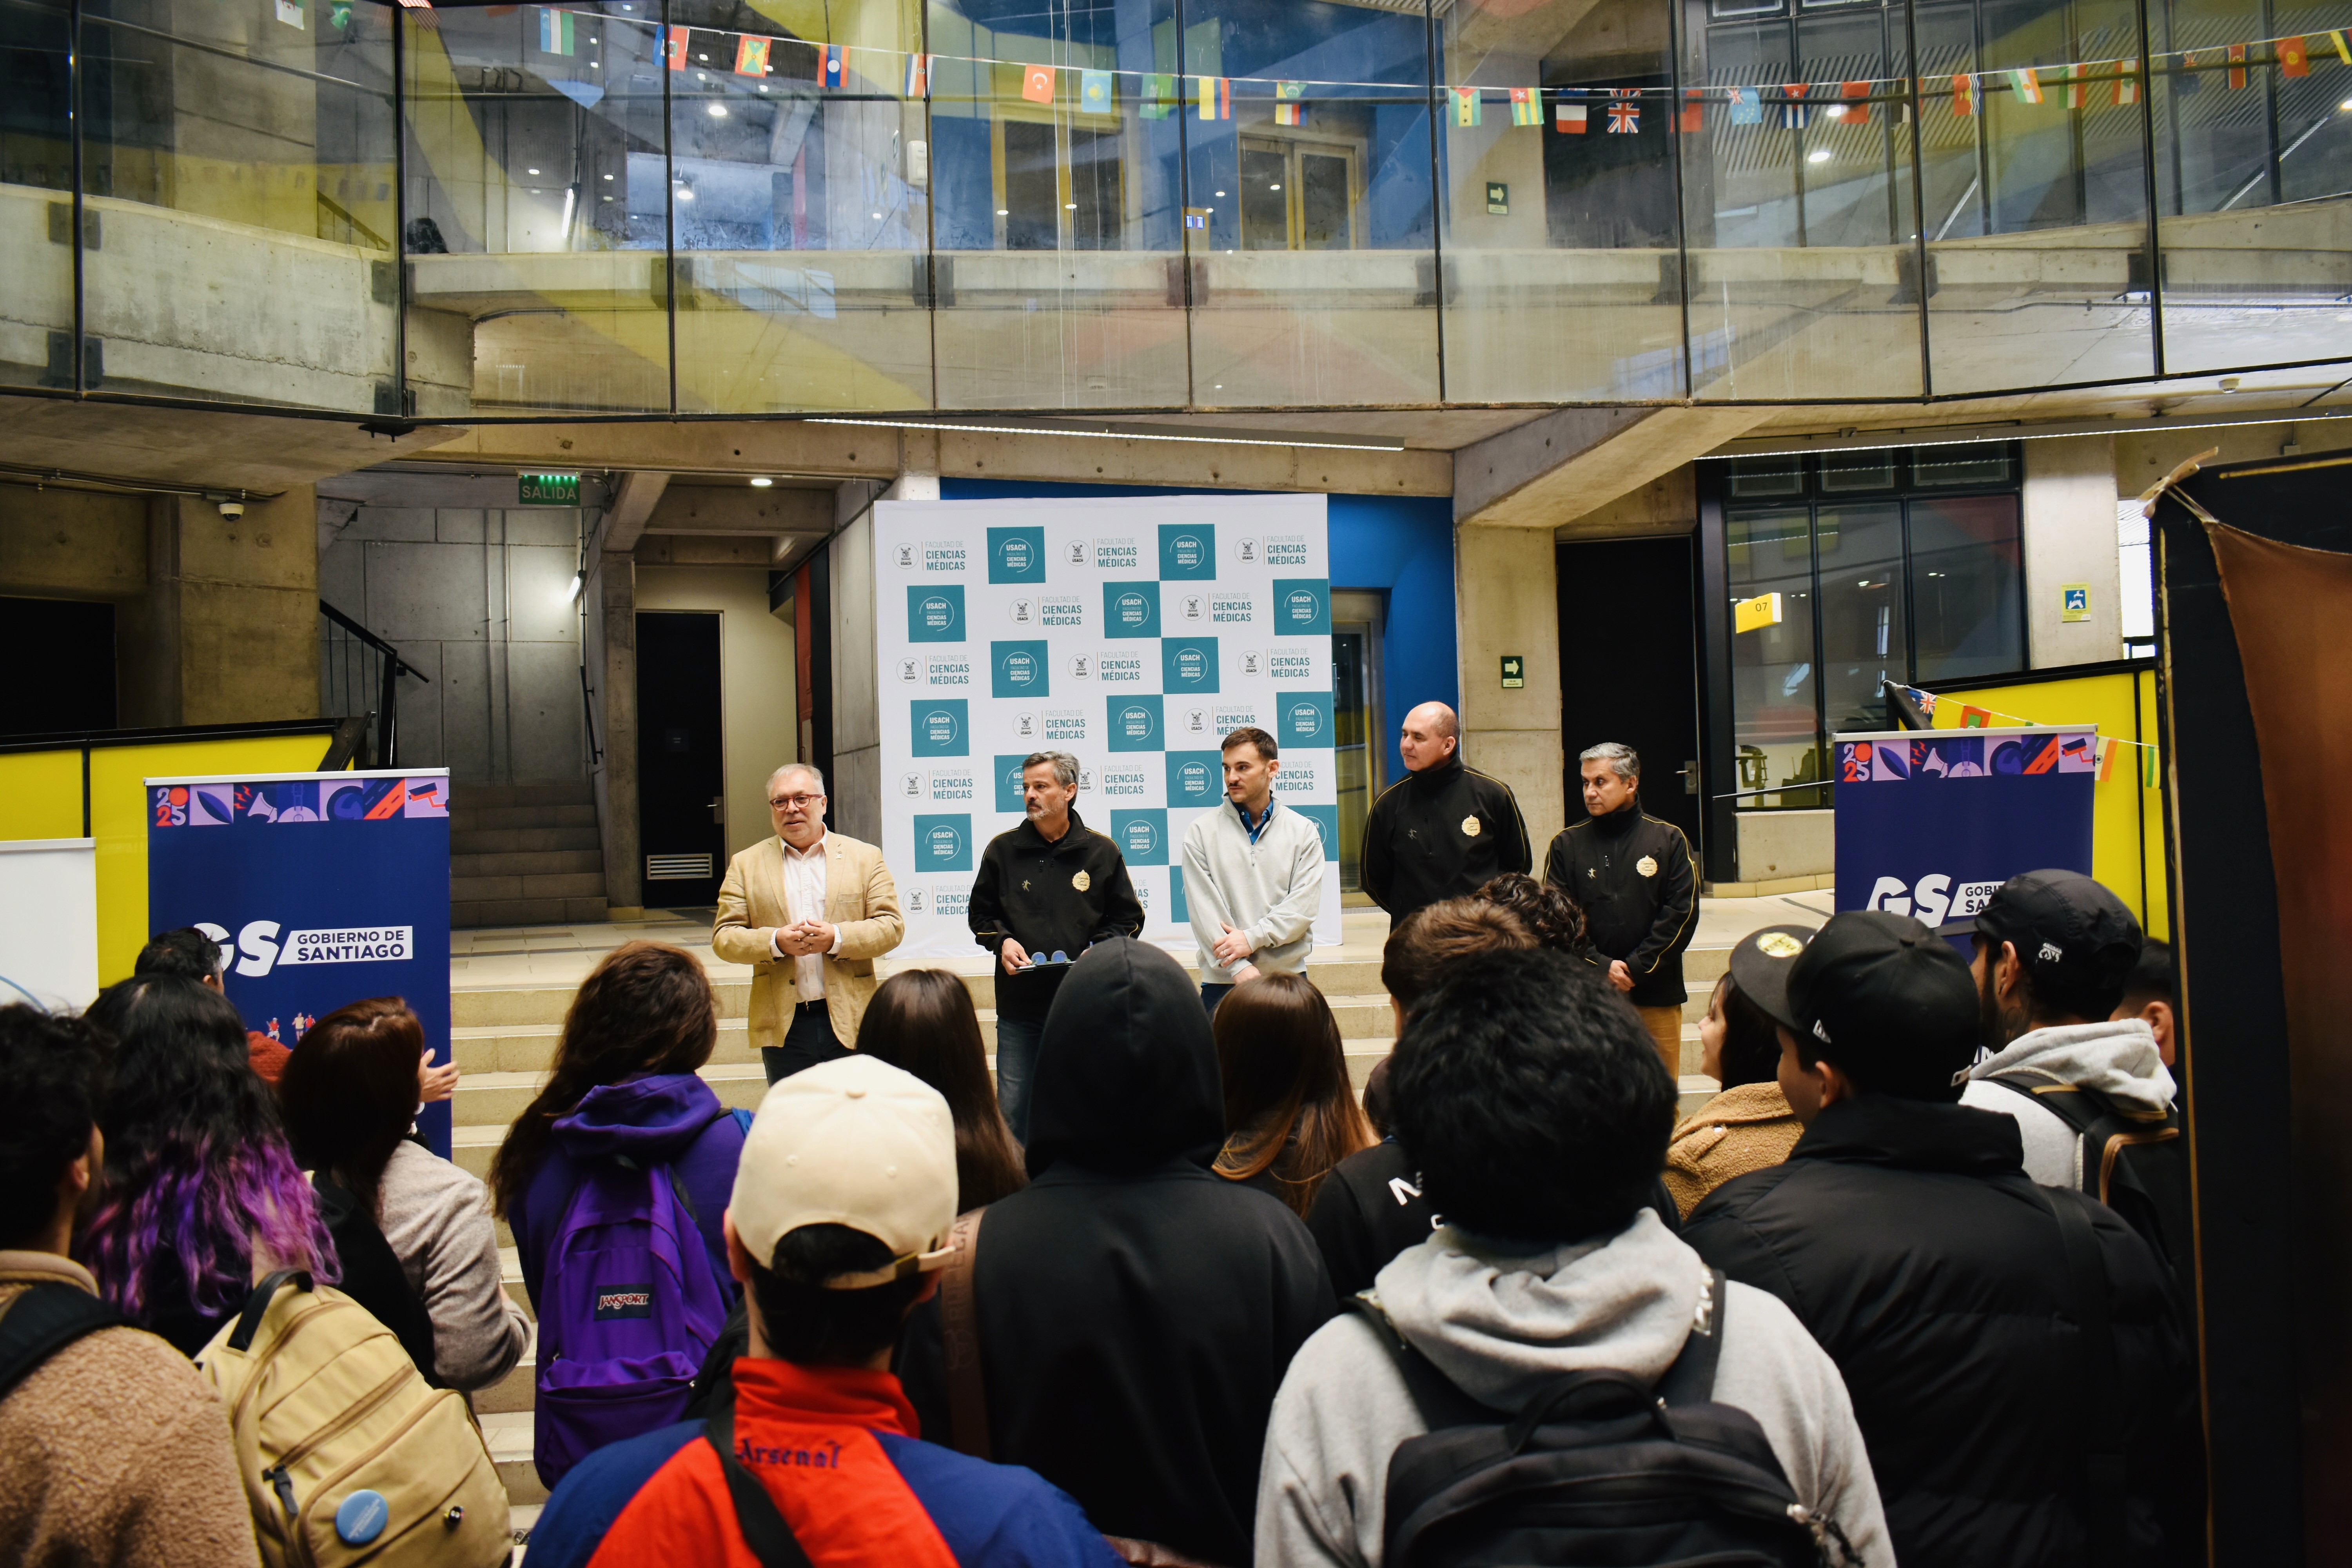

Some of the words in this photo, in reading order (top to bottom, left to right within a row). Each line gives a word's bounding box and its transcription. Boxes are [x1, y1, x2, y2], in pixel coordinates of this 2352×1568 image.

[522, 485, 576, 500] SALIDA
[1097, 547, 1137, 556] CIENCIAS
[1267, 544, 1307, 554] CIENCIAS
[926, 550, 966, 559] CIENCIAS
[1268, 554, 1306, 564] MÉDICAS
[927, 560, 965, 570] MÉDICAS
[1098, 557, 1136, 567] MÉDICAS
[1042, 605, 1082, 614] CIENCIAS
[1212, 602, 1252, 611] CIENCIAS
[1755, 602, 1767, 612] 07
[1043, 615, 1081, 625] MÉDICAS
[1213, 611, 1251, 622] MÉDICAS
[1101, 661, 1141, 670] CIENCIAS
[1271, 657, 1310, 666] CIENCIAS
[929, 664, 969, 673] CIENCIAS
[1272, 667, 1309, 677] MÉDICAS
[930, 674, 968, 684] MÉDICAS
[1102, 670, 1140, 681] MÉDICAS
[1046, 719, 1086, 728] CIENCIAS
[1216, 715, 1256, 724] CIENCIAS
[1047, 729, 1085, 739] MÉDICAS
[933, 779, 973, 788] CIENCIAS
[1105, 774, 1144, 783] CIENCIAS
[1105, 784, 1143, 794] MÉDICAS
[1276, 780, 1314, 791] MÉDICAS
[934, 788, 972, 799] MÉDICAS
[936, 894, 970, 903] CIENCIA
[937, 904, 969, 915] MÉDICA
[298, 931, 379, 944] GOBIERNO
[385, 930, 404, 941] DE
[297, 944, 404, 961] SANTIAGO
[598, 1293, 649, 1310] JANSPORT
[735, 1438, 842, 1468] Arsenal
